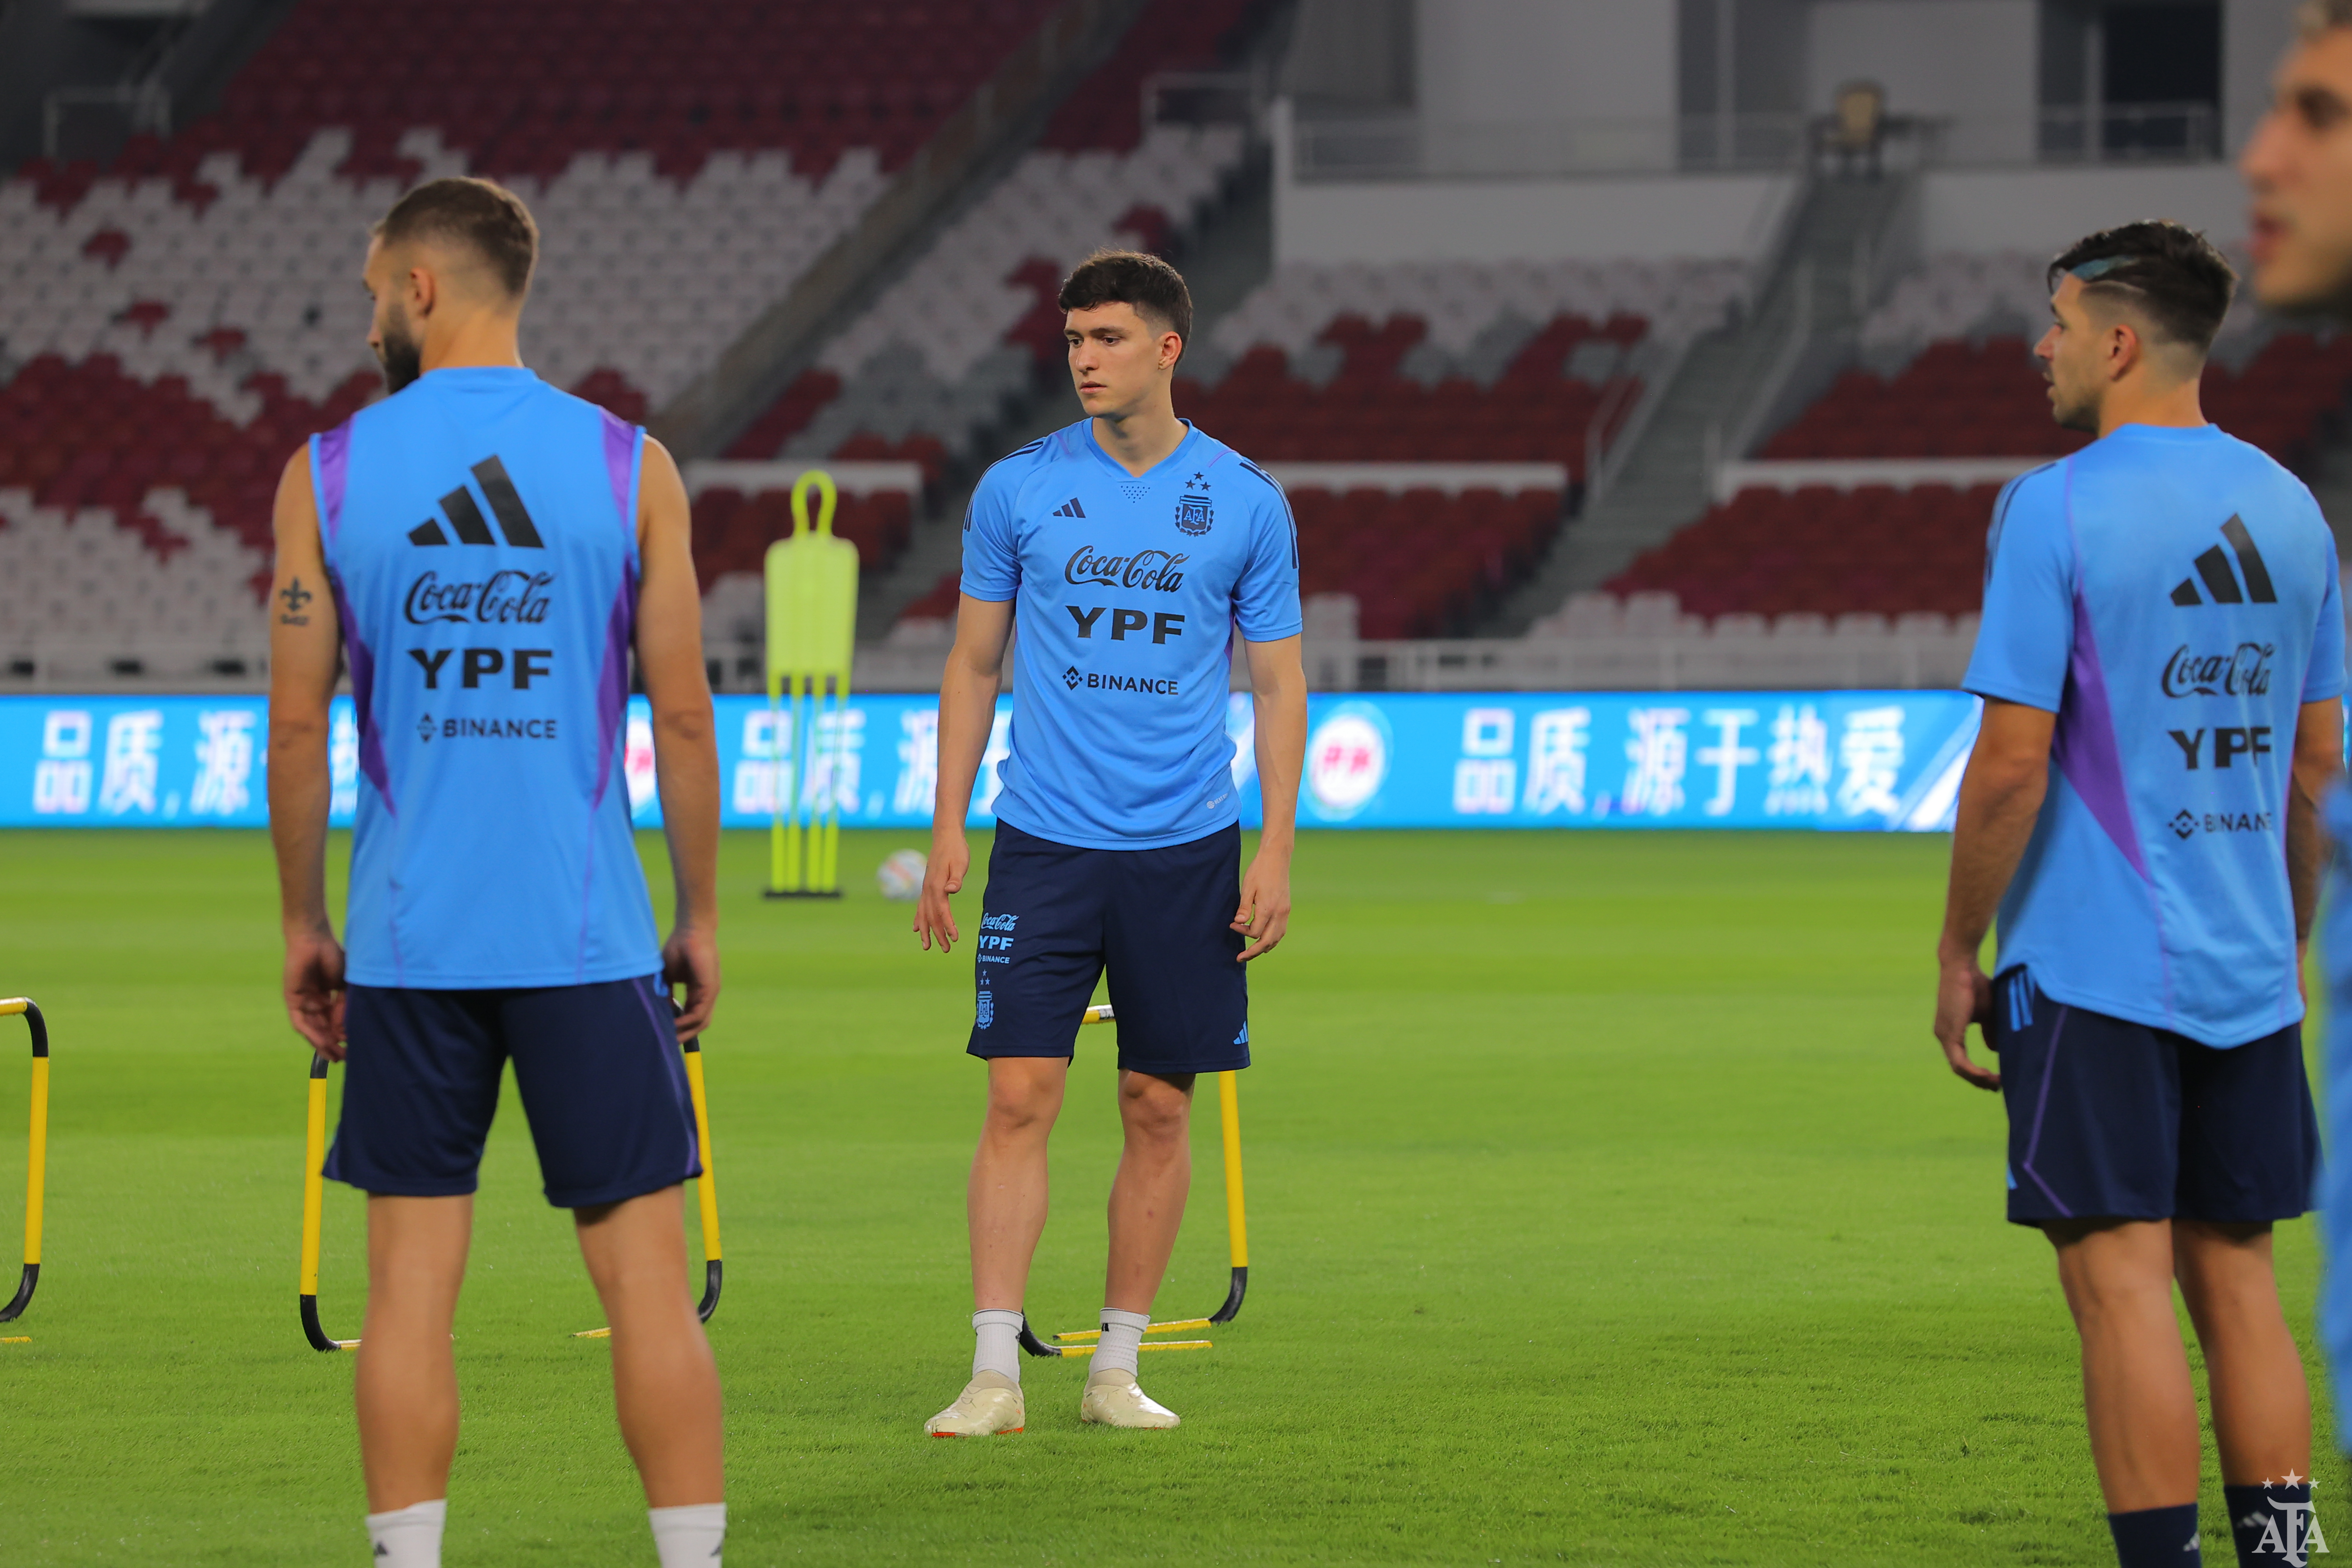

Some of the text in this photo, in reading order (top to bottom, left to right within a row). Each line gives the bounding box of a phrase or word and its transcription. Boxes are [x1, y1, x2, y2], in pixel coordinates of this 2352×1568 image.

[1184, 506, 1205, 525] AFA
[1065, 546, 1190, 593] Coca-Cola
[1065, 606, 1185, 644] YPF
[407, 648, 553, 690] YPF
[1087, 674, 1179, 695] BINANCE
[443, 719, 558, 739] BINANCE
[2167, 727, 2271, 770] YPF
[979, 935, 1014, 951] YPF
[982, 955, 1010, 964] BINANCE
